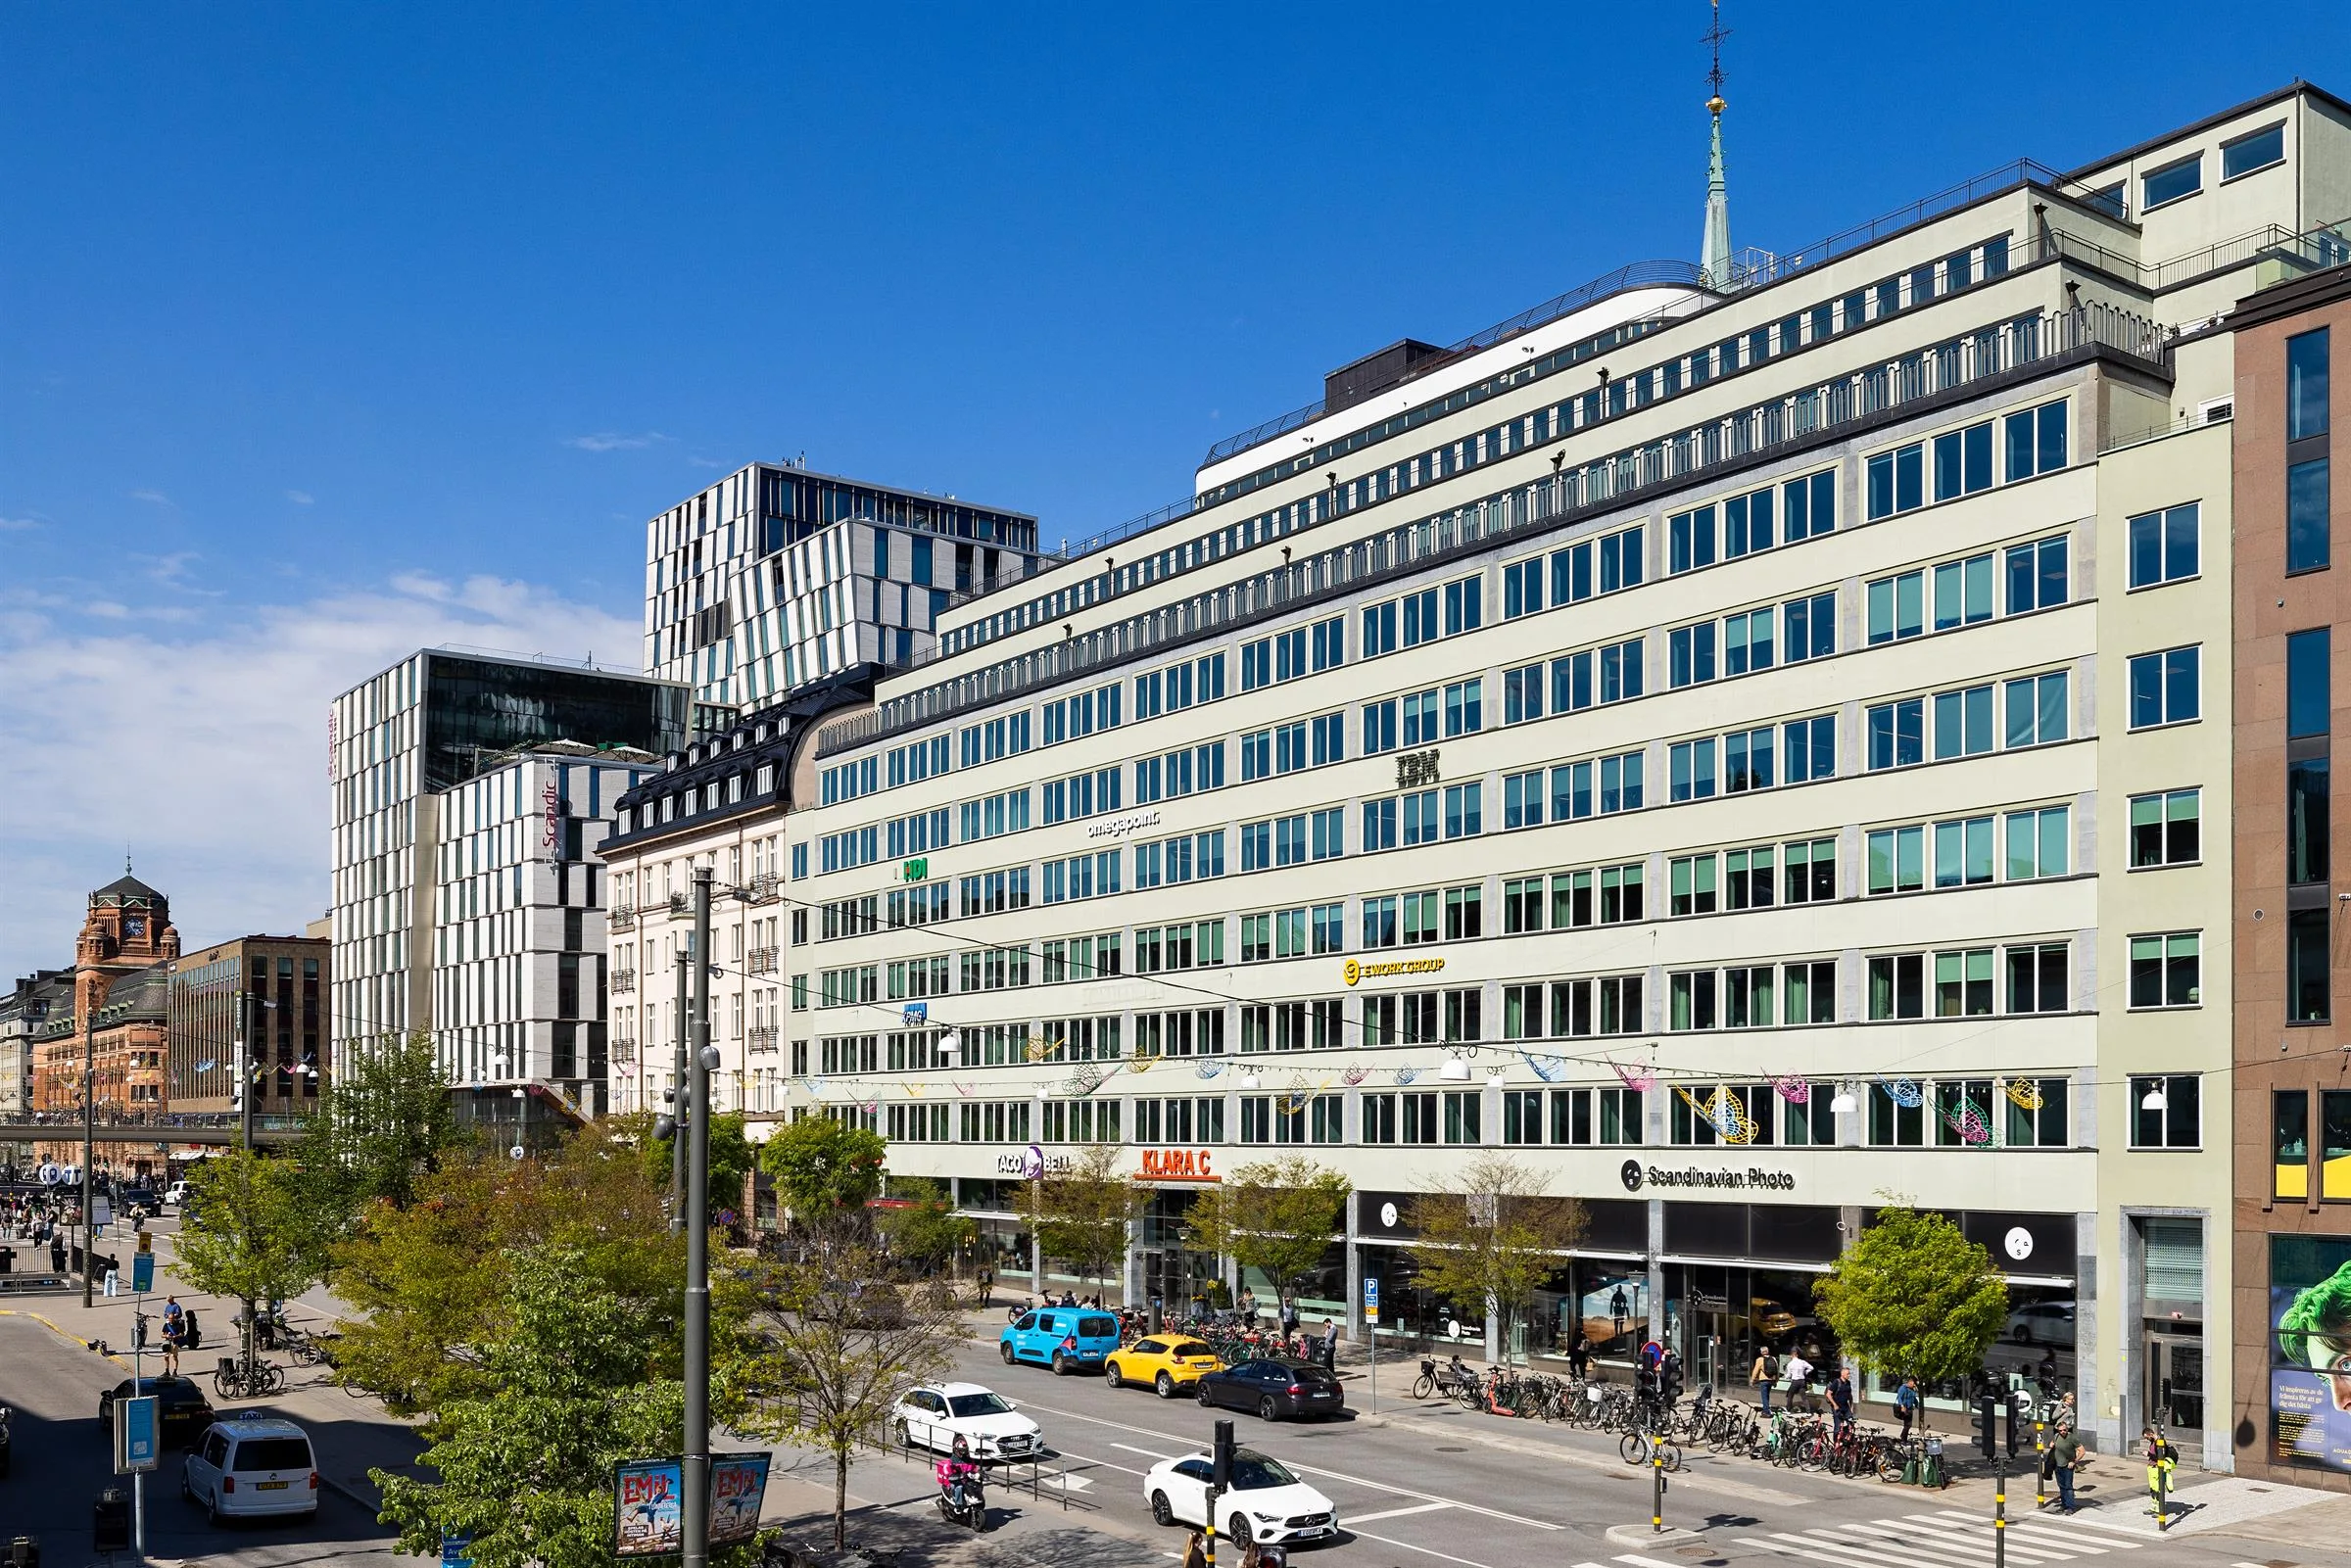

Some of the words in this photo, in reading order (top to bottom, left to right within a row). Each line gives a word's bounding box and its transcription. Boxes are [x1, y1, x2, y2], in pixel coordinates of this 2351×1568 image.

[1395, 749, 1439, 784] IBM
[542, 781, 555, 847] Scandic
[904, 858, 928, 881] HDI
[1365, 963, 1405, 977] EWORK
[1407, 958, 1445, 973] GROUP
[901, 1010, 923, 1025] KPMG
[997, 1156, 1023, 1172] TACO
[1142, 1150, 1195, 1175] KLARA
[1198, 1150, 1211, 1175] C
[1648, 1165, 1744, 1187] Scandinavian
[1748, 1167, 1796, 1189] Photo
[1367, 1280, 1375, 1294] P
